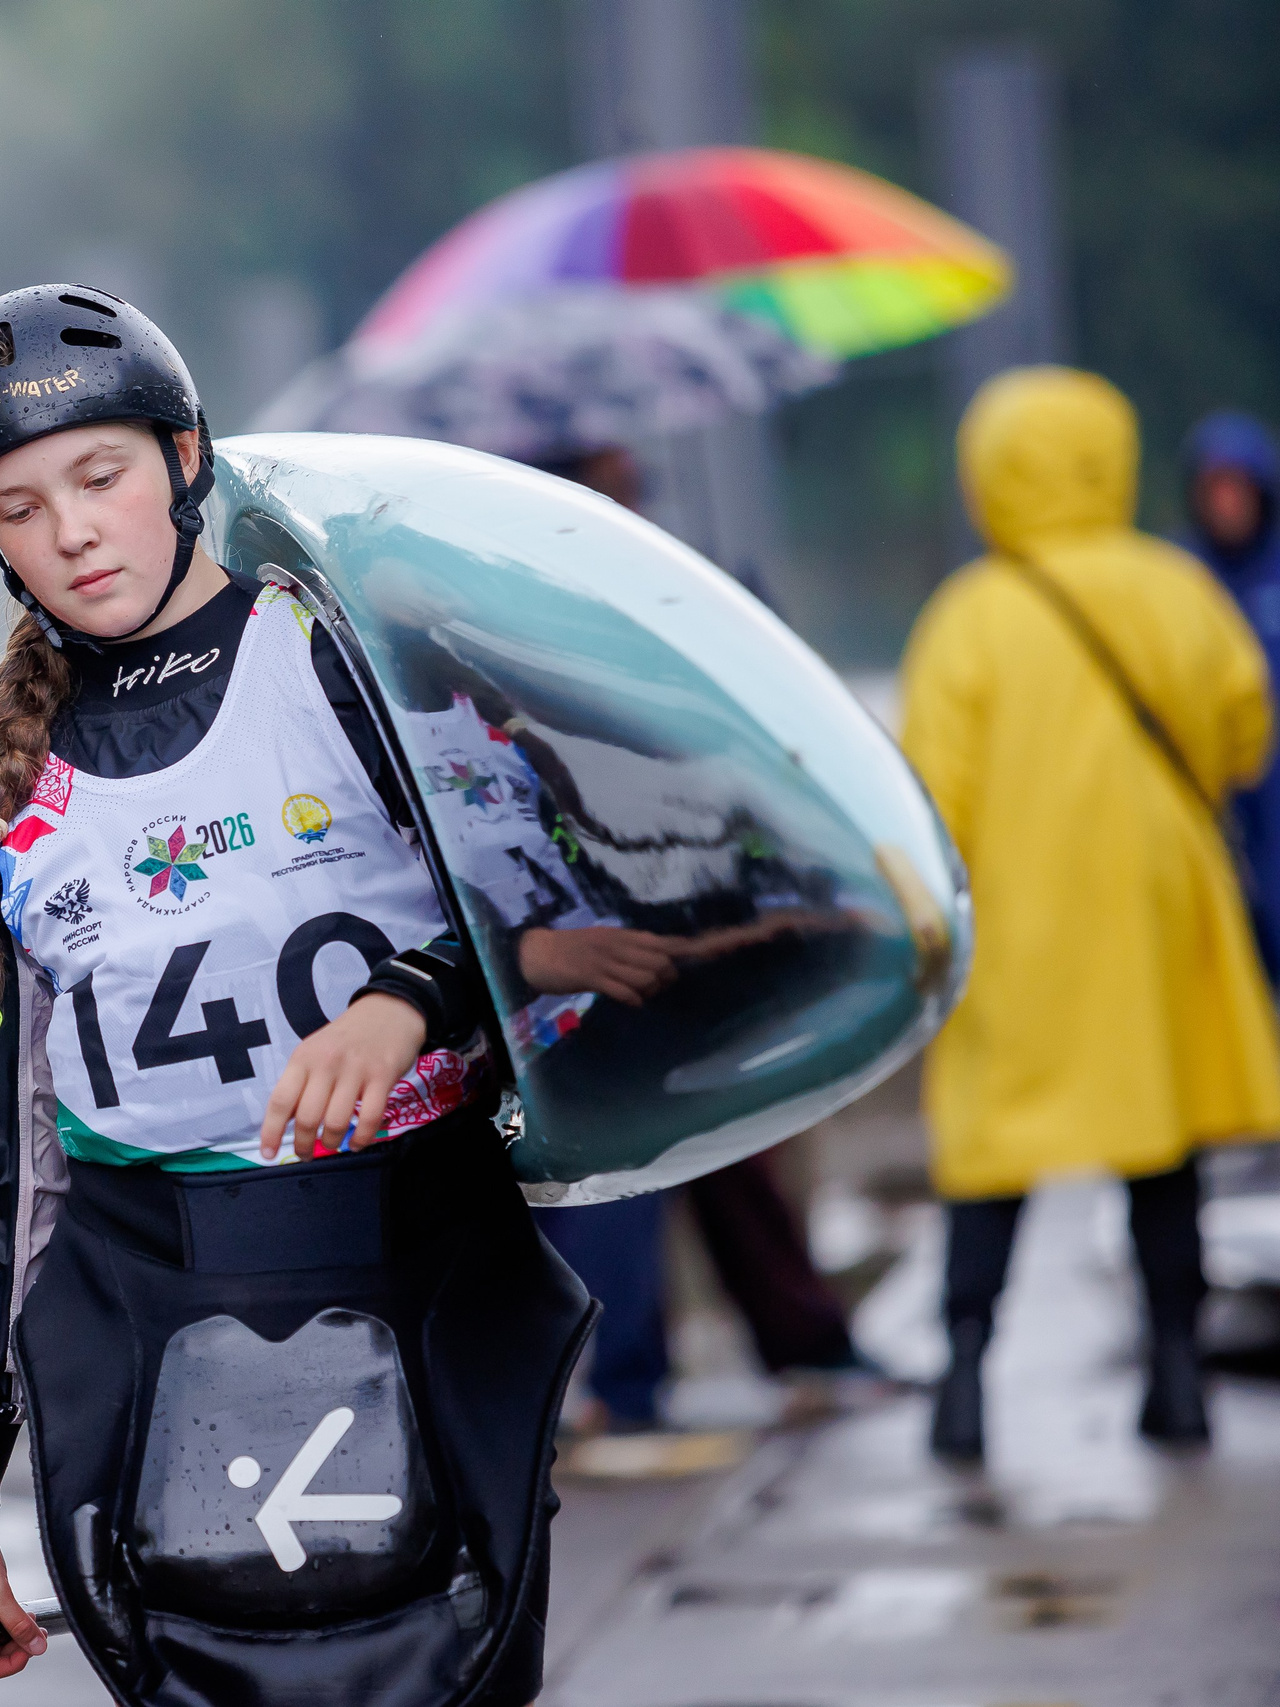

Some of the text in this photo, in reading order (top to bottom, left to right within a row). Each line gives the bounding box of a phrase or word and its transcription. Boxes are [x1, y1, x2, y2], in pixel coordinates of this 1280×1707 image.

[195, 812, 256, 860] 2026
[123, 814, 211, 916] СПАРТАКИАДА НАРОДОВ РОССИИ
[62, 921, 102, 946] МИНСПОРТ
[67, 934, 100, 953] РОССИИ
[67, 911, 398, 1110] 140
